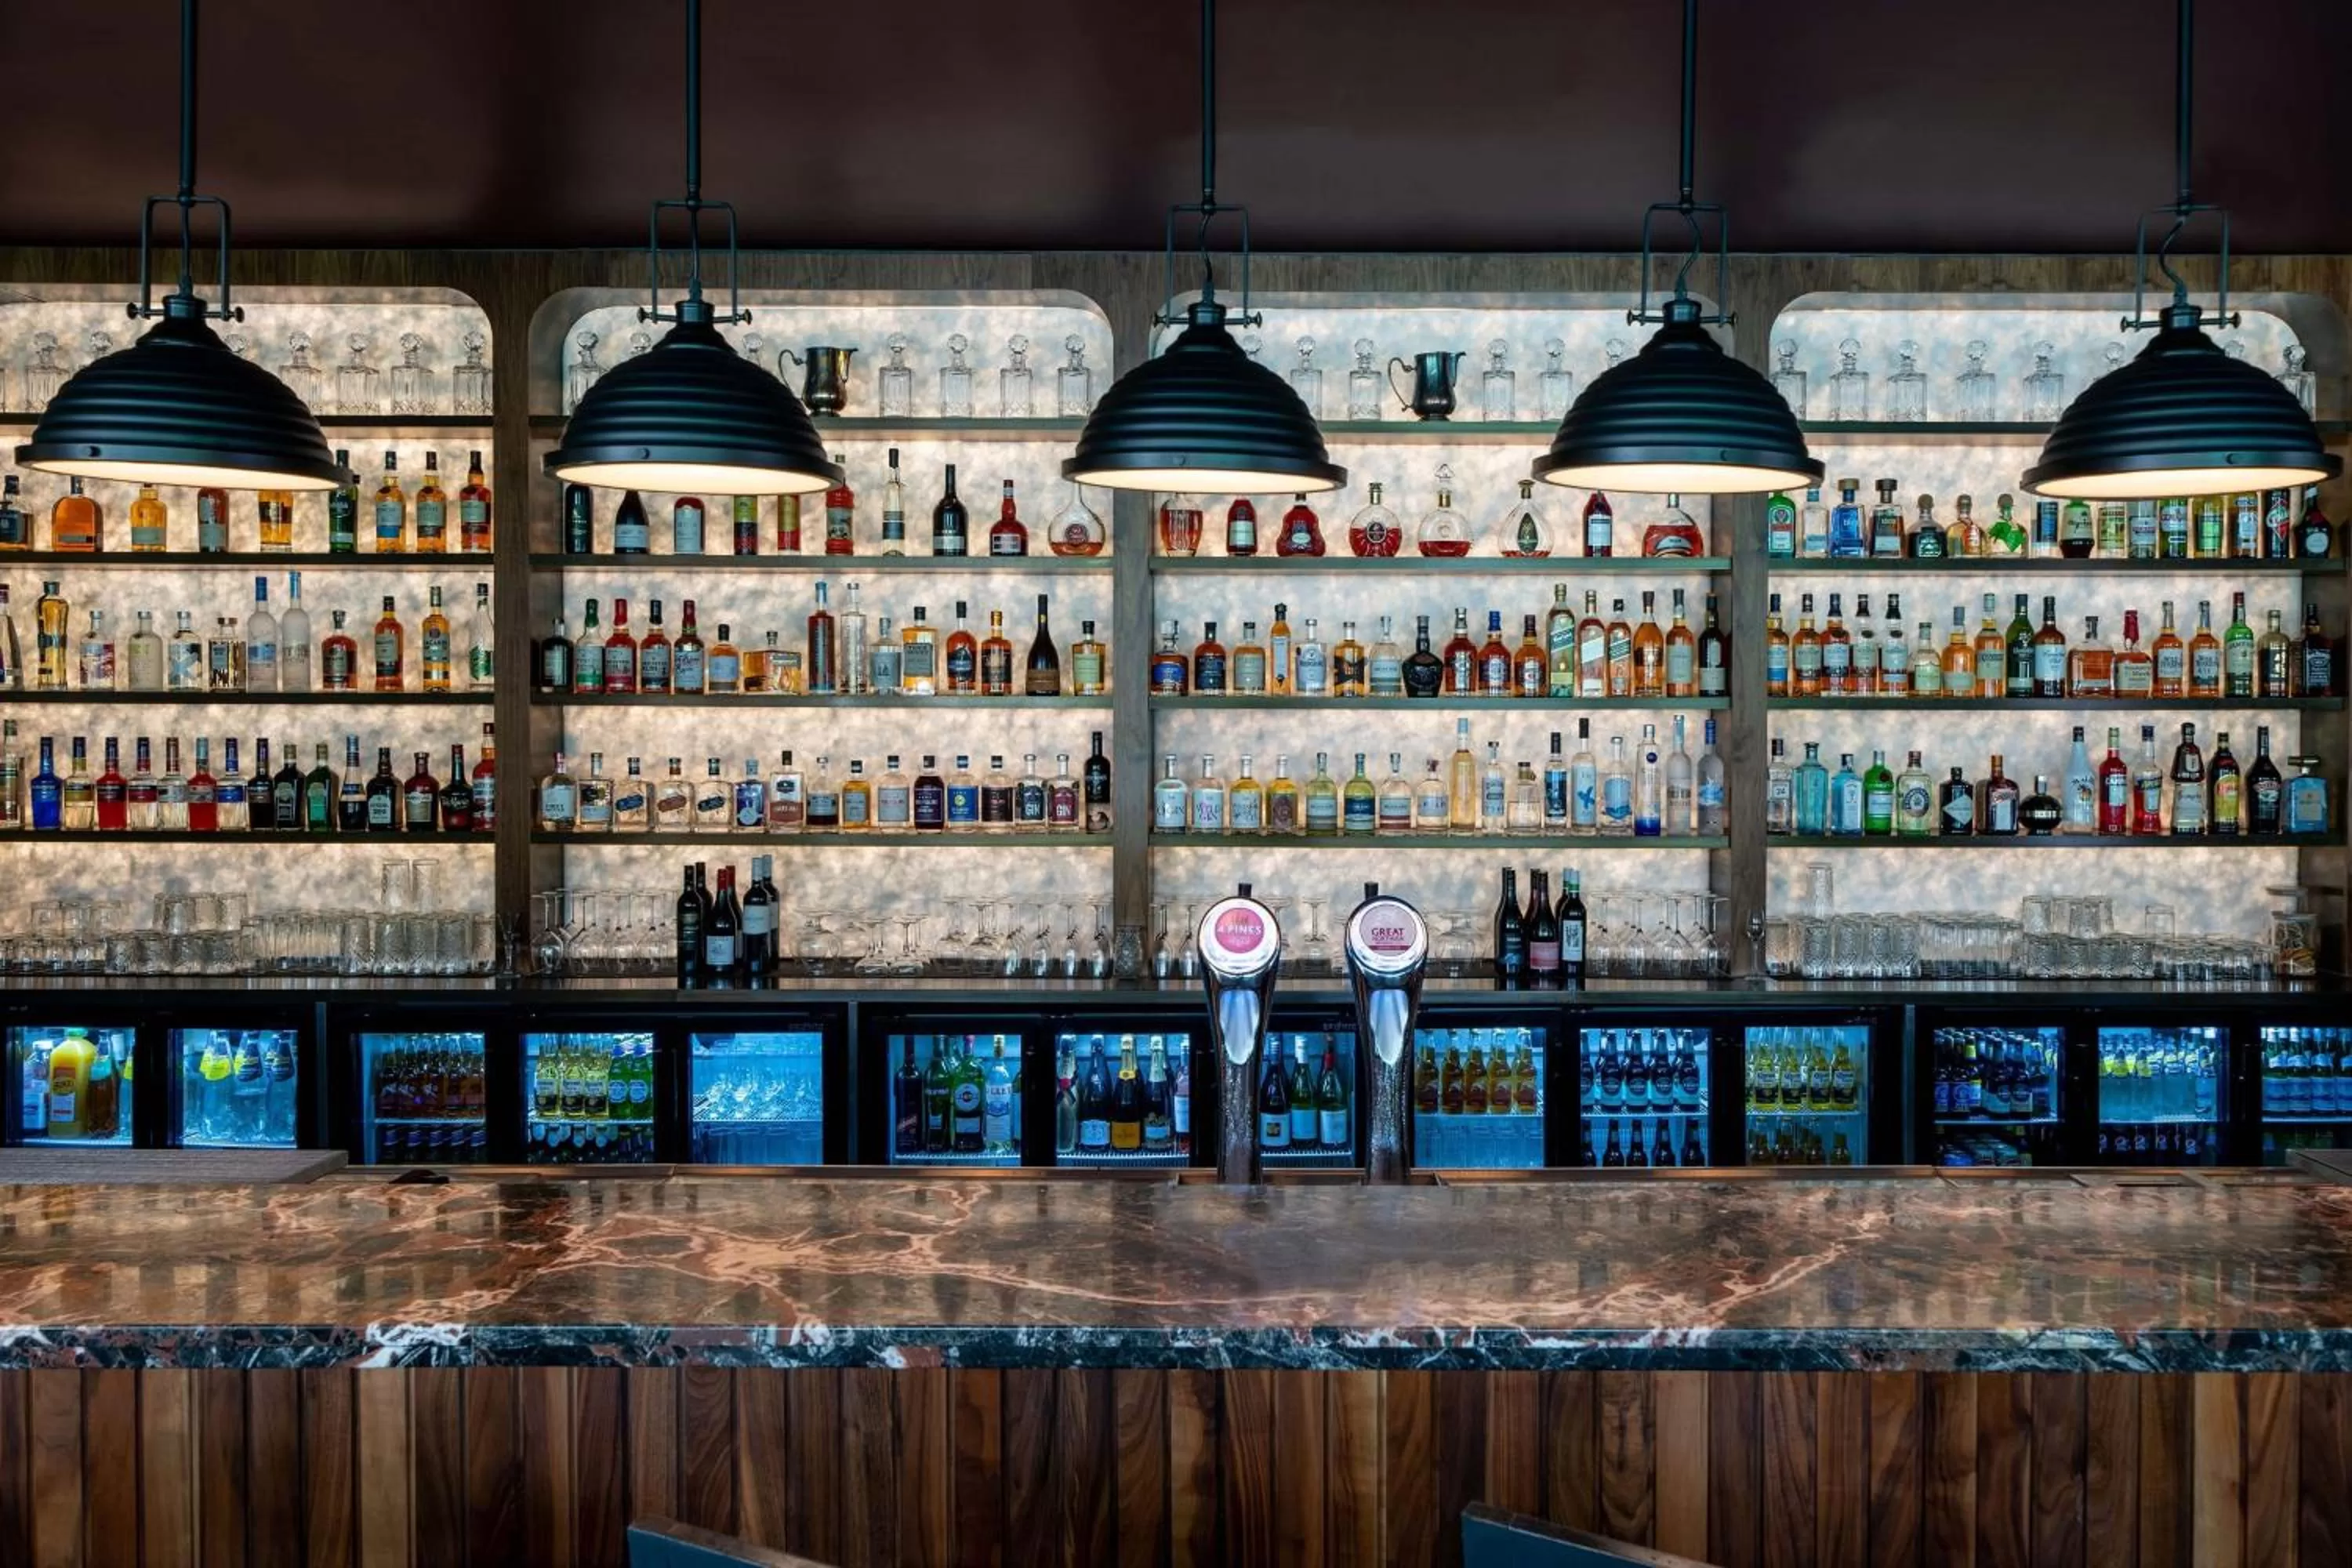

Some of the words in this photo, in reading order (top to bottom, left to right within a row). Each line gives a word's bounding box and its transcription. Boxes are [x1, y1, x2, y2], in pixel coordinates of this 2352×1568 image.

[1025, 804, 1041, 816] GIN
[1056, 804, 1072, 816] GIN
[1371, 927, 1405, 937] GREAT
